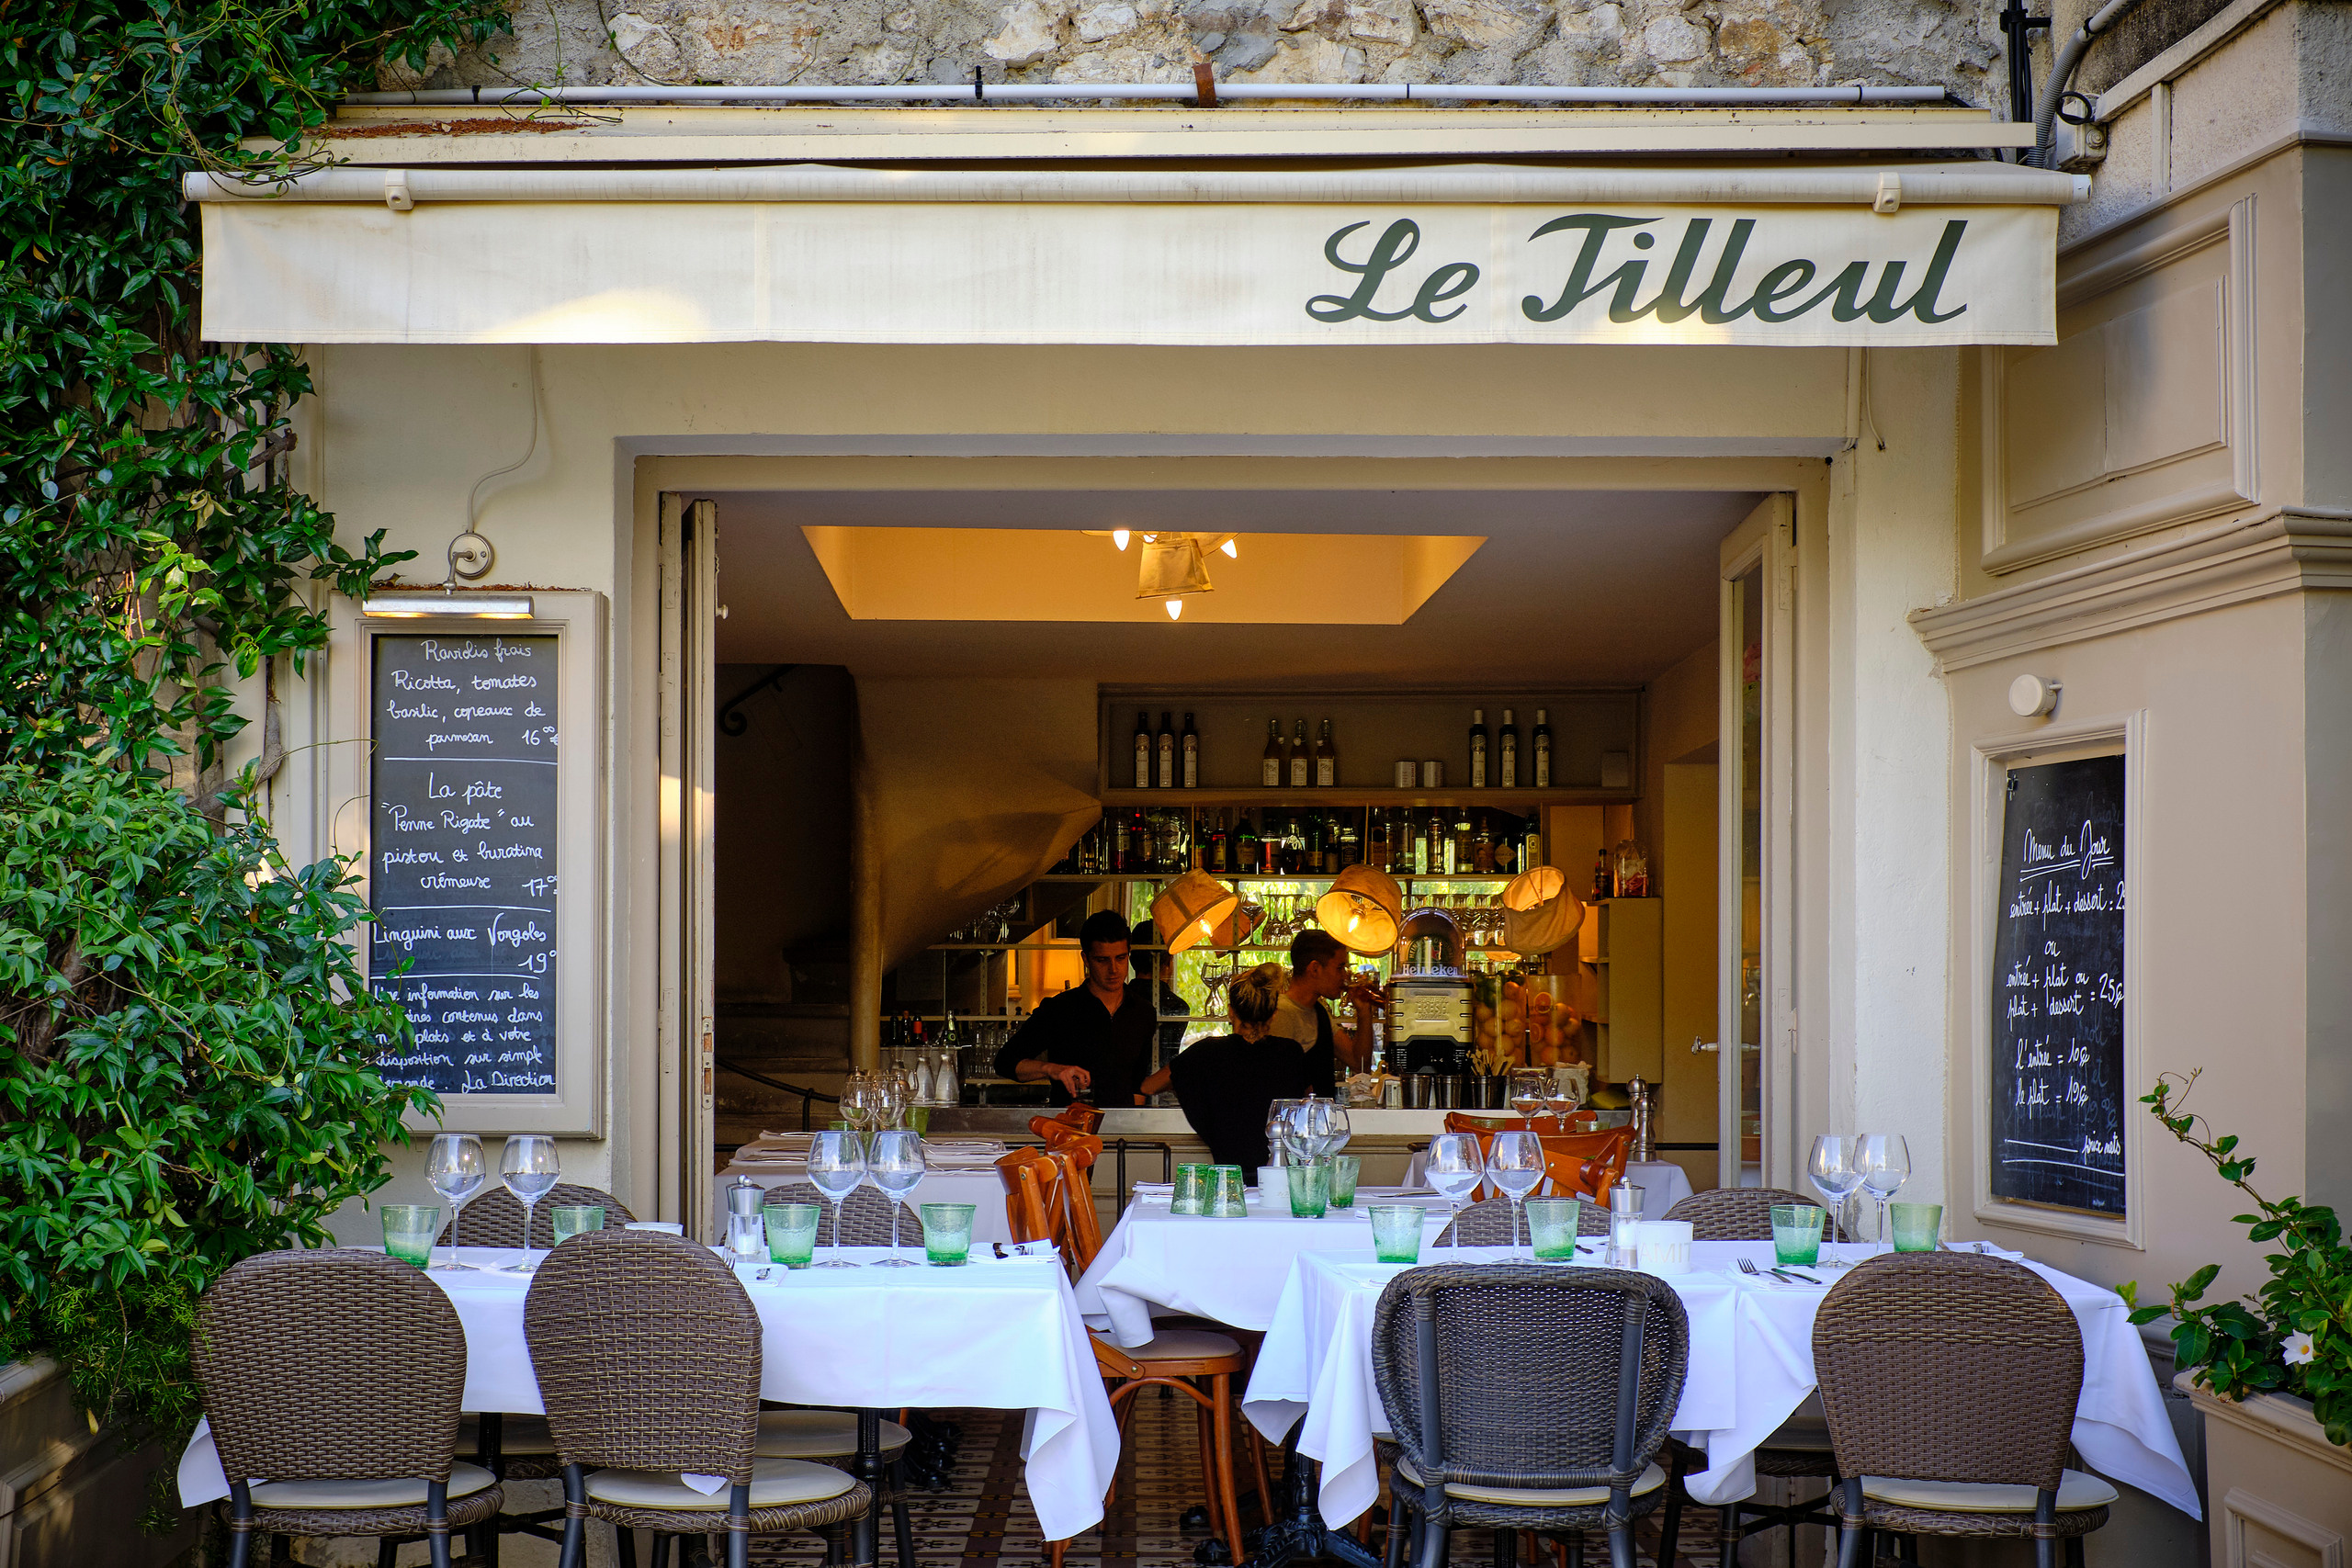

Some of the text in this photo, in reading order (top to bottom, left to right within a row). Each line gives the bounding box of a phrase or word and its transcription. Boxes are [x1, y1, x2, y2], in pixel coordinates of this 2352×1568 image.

[1305, 213, 1970, 325] Le Tilleul
[421, 637, 532, 662] Raviolis frais
[390, 670, 537, 694] Ricotta, tomates
[387, 699, 546, 723] basilic, copeaux de
[425, 732, 493, 751] parmesan
[428, 772, 503, 805] La pâte
[510, 815, 535, 828] au
[382, 840, 544, 874] pistou et buratina
[2023, 819, 2110, 880] Menu du Jour
[2041, 879, 2064, 931] plat
[2074, 883, 2108, 913] dessert
[373, 912, 547, 951] Linguini aux Vongoles
[2044, 940, 2061, 957] ou
[407, 983, 480, 1009] information
[487, 990, 514, 1002] sur
[517, 982, 539, 1000] les
[2043, 962, 2070, 1009] plat
[2075, 972, 2090, 985] ou
[442, 1010, 499, 1024] contenus
[507, 1008, 544, 1022] dans
[2007, 994, 2030, 1032] plat
[2050, 989, 2085, 1016] dessert
[413, 1026, 532, 1050] plats et à votre
[375, 1044, 542, 1071] disposition sur simple
[462, 1070, 487, 1094] La
[491, 1069, 556, 1089] Direction
[2016, 1077, 2026, 1107] le
[2027, 1077, 2050, 1120] plat
[2081, 1130, 2104, 1166] prix
[2104, 1131, 2121, 1156] nets
